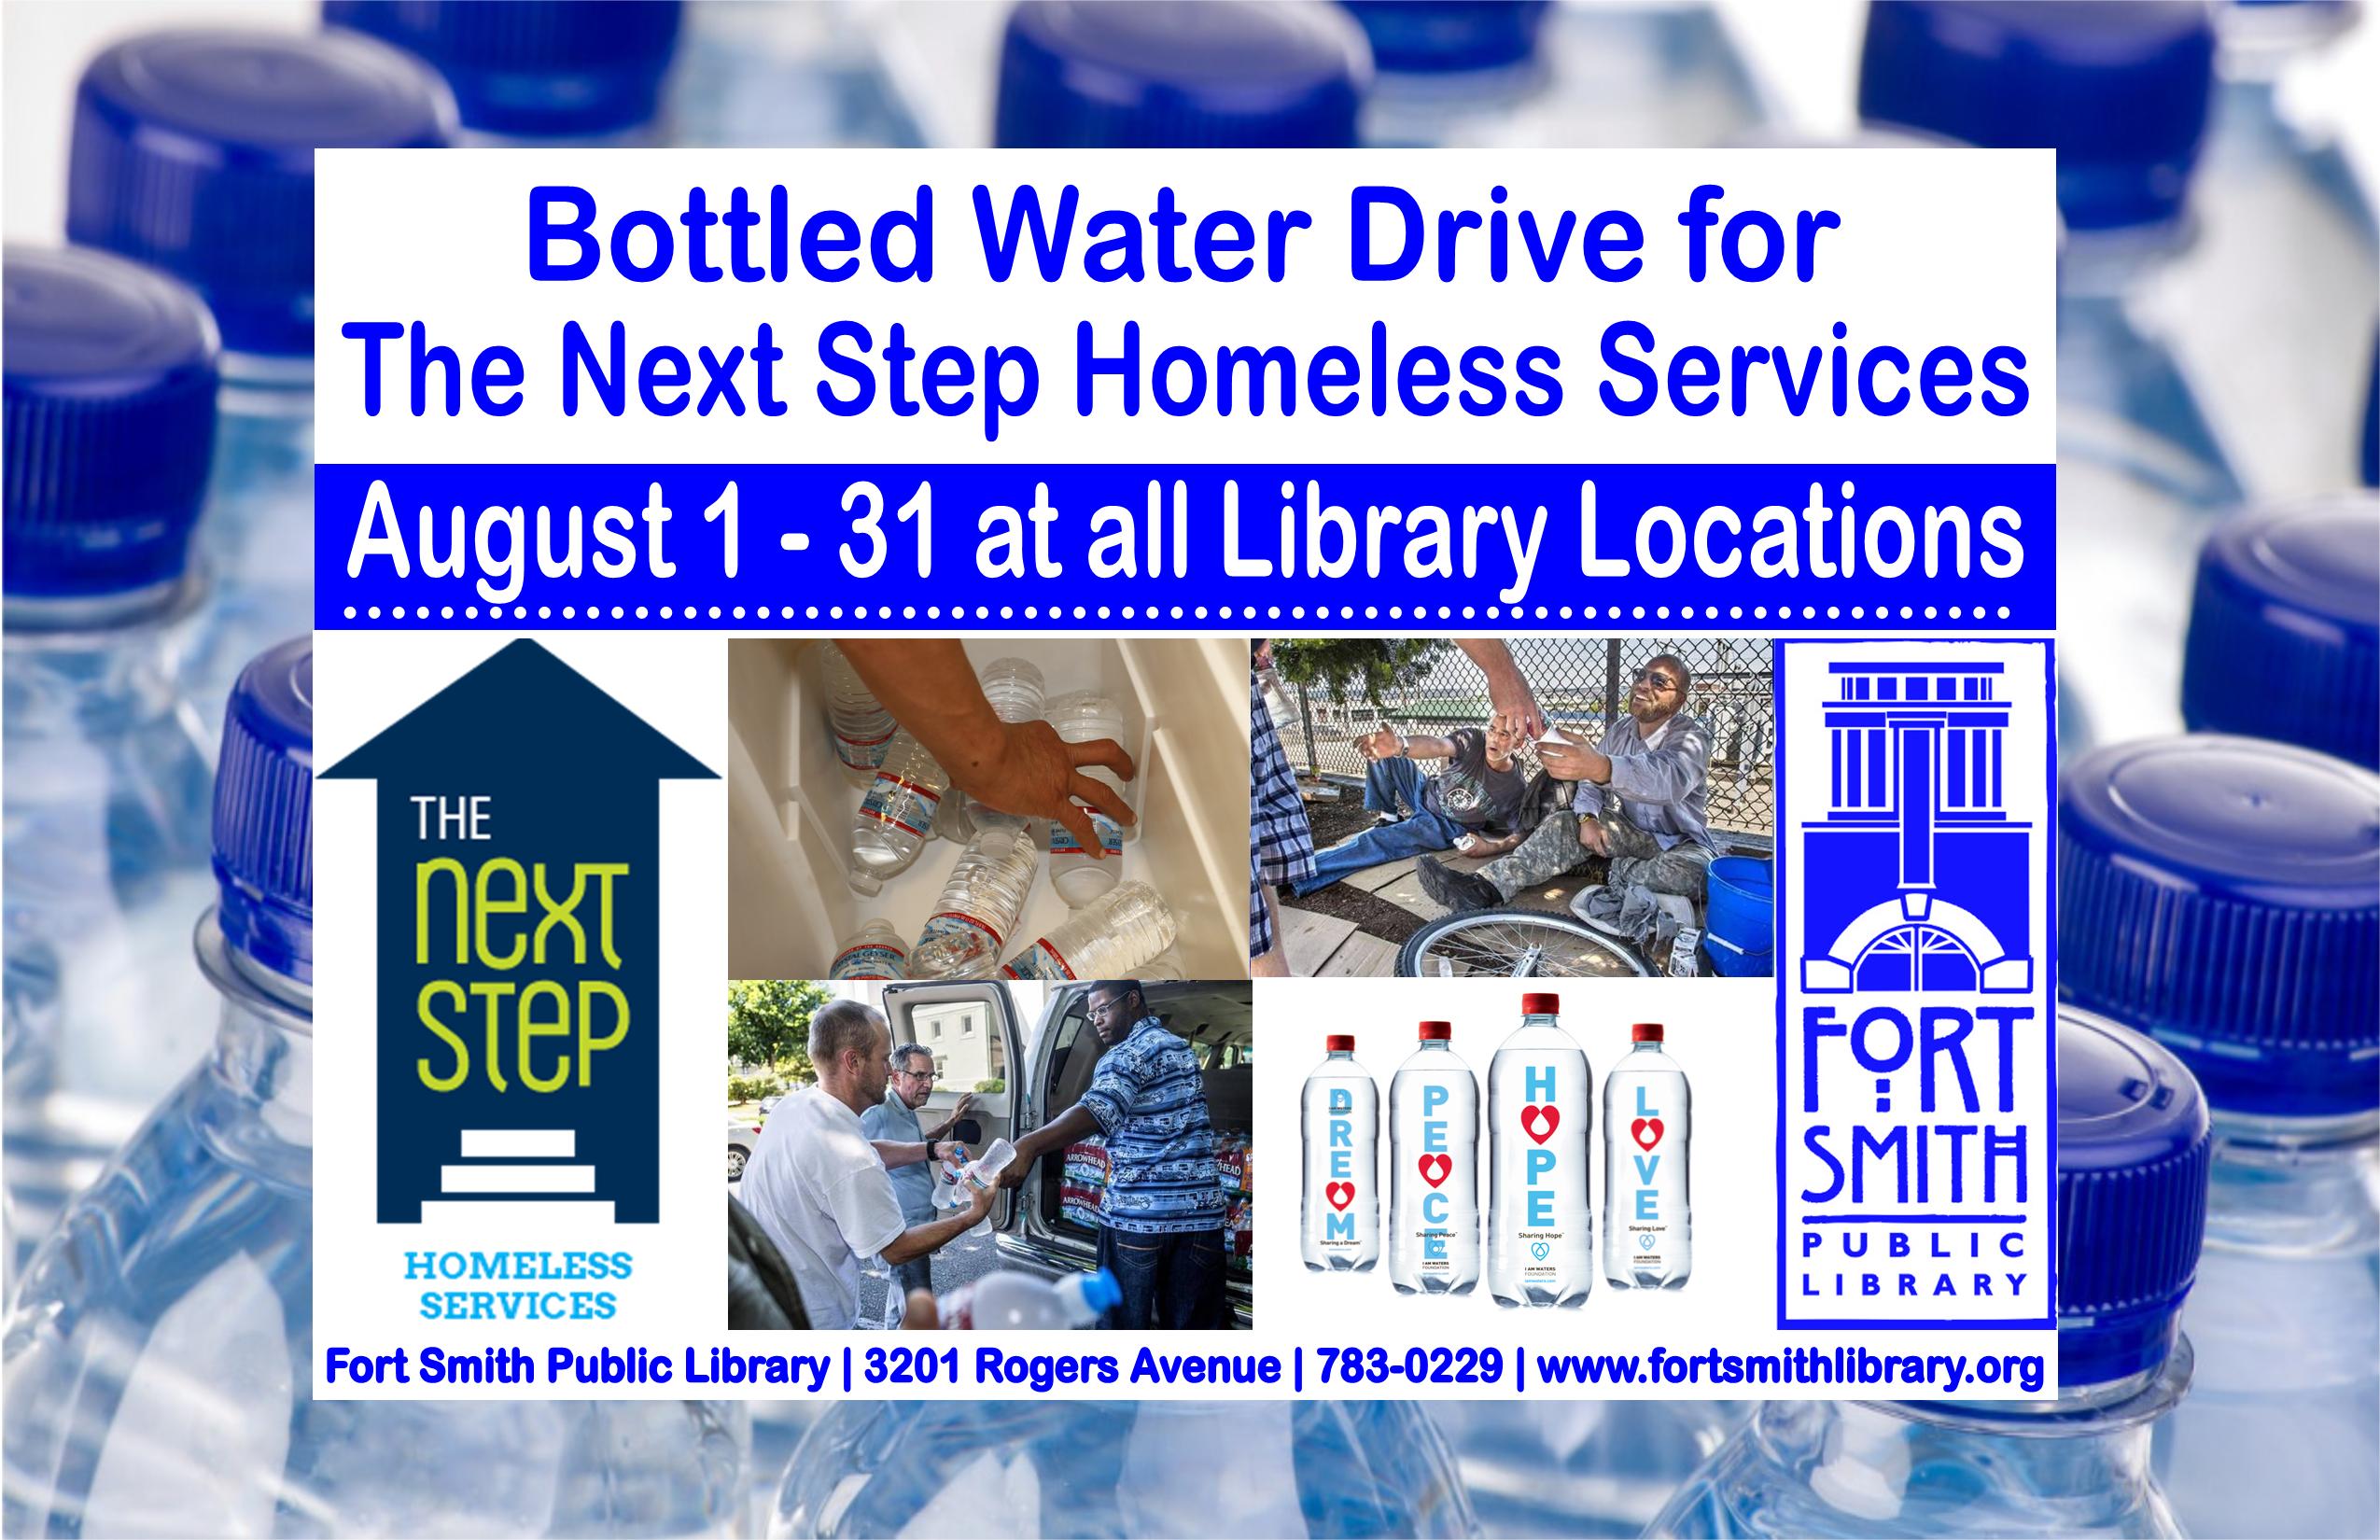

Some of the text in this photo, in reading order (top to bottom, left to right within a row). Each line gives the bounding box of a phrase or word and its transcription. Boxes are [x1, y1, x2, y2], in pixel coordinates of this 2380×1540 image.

[529, 185, 1841, 284] Bottled Water Drive for
[342, 321, 2030, 442] The Next Step Homeless Services
[346, 479, 2024, 604] August 1 - 31 at all Library Locations
[411, 796, 491, 840] THE
[1802, 1006, 2035, 1113] FORT
[1066, 1154, 1106, 1169] ARROWHEAD
[1800, 1125, 2028, 1204] SMITH
[1063, 1197, 1100, 1214] ARROWHEAD
[1518, 1232, 1544, 1240] Sharing
[1802, 1232, 2023, 1258] PUBLIC
[404, 1252, 634, 1280] HOMELESS
[1802, 1273, 2027, 1296] LIBRARY
[420, 1291, 617, 1320] SERVICES
[326, 1347, 411, 1384] Fort
[419, 1346, 535, 1384] Smith
[548, 1346, 673, 1384] Public
[685, 1346, 832, 1393] Library
[864, 1347, 959, 1384] 3201
[975, 1347, 1119, 1393] Rogers
[1129, 1346, 1281, 1384] Avenue
[1316, 1346, 1504, 1384] 783-0229
[1536, 1346, 2044, 1393] www.fortsmithlibrary.org
